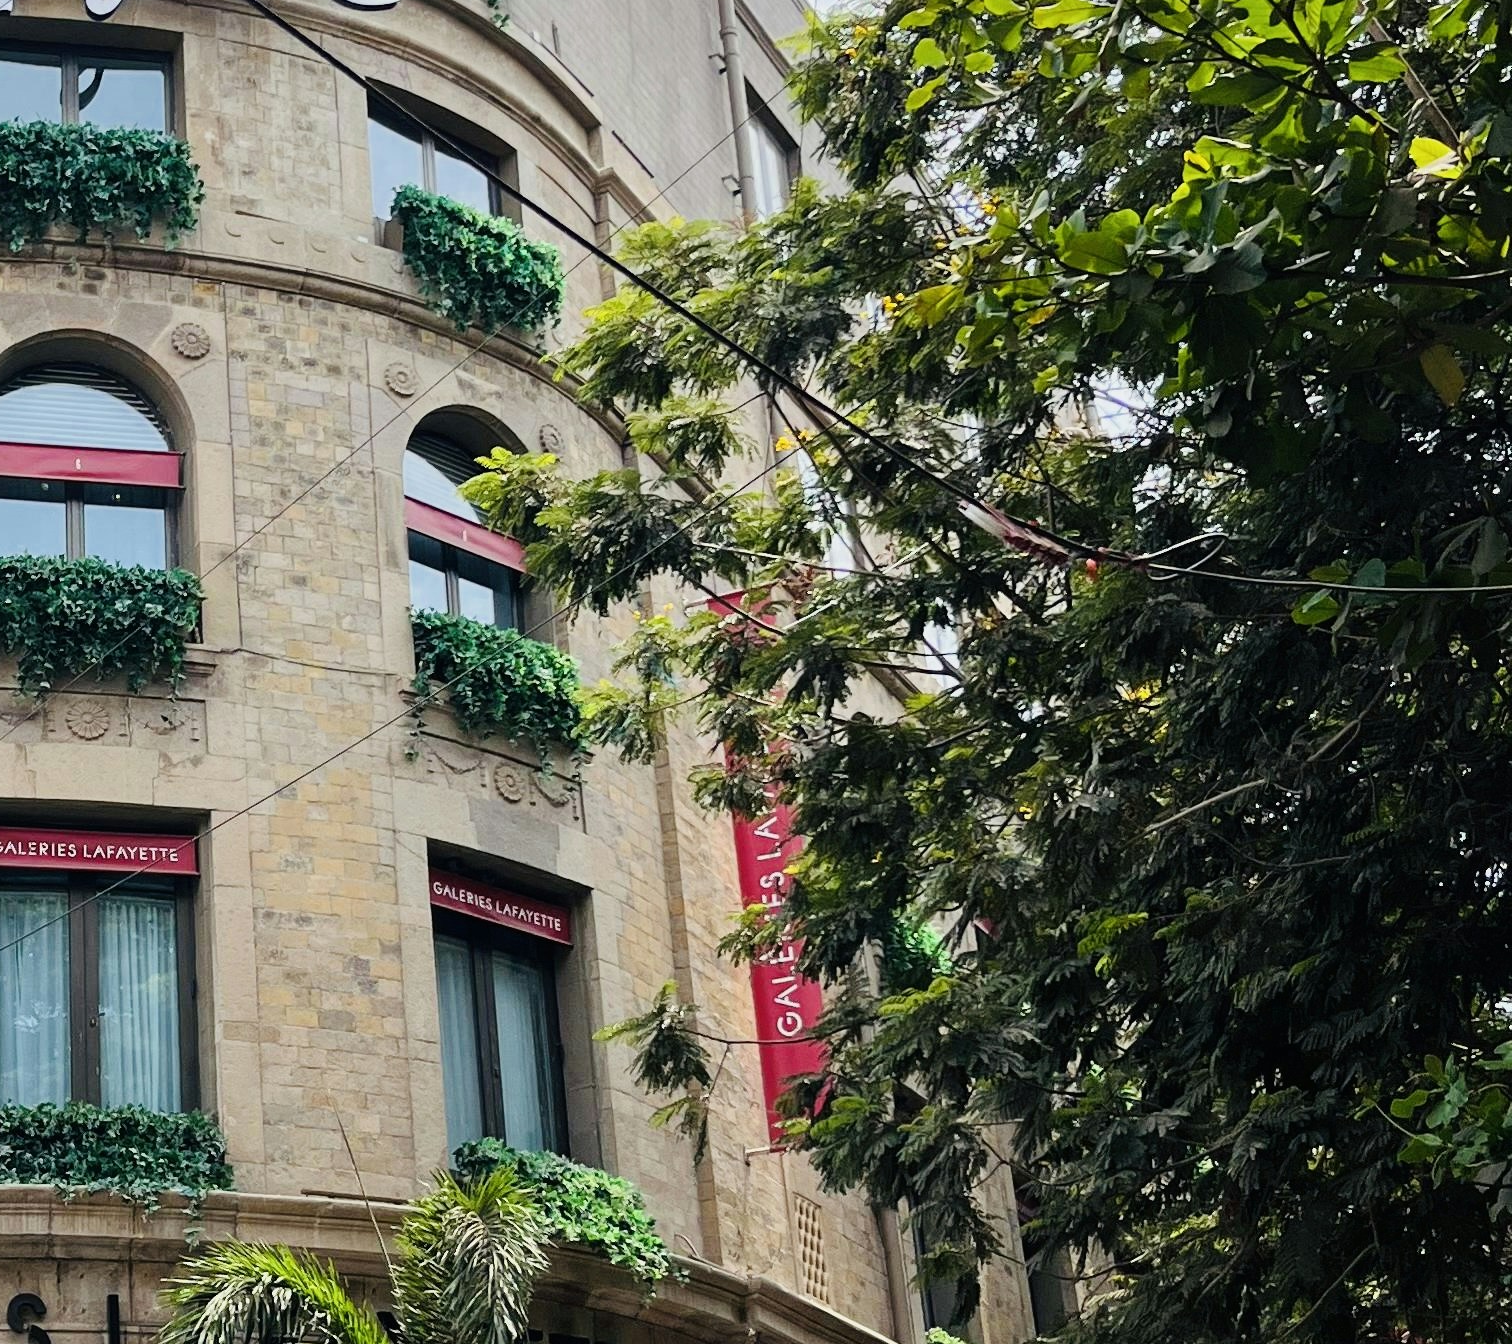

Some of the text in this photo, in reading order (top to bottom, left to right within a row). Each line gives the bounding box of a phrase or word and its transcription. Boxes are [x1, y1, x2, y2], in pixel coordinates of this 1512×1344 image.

[83, 845, 178, 862] LAFAYETTE
[433, 881, 561, 931] GALERIES LAFAYETTE
